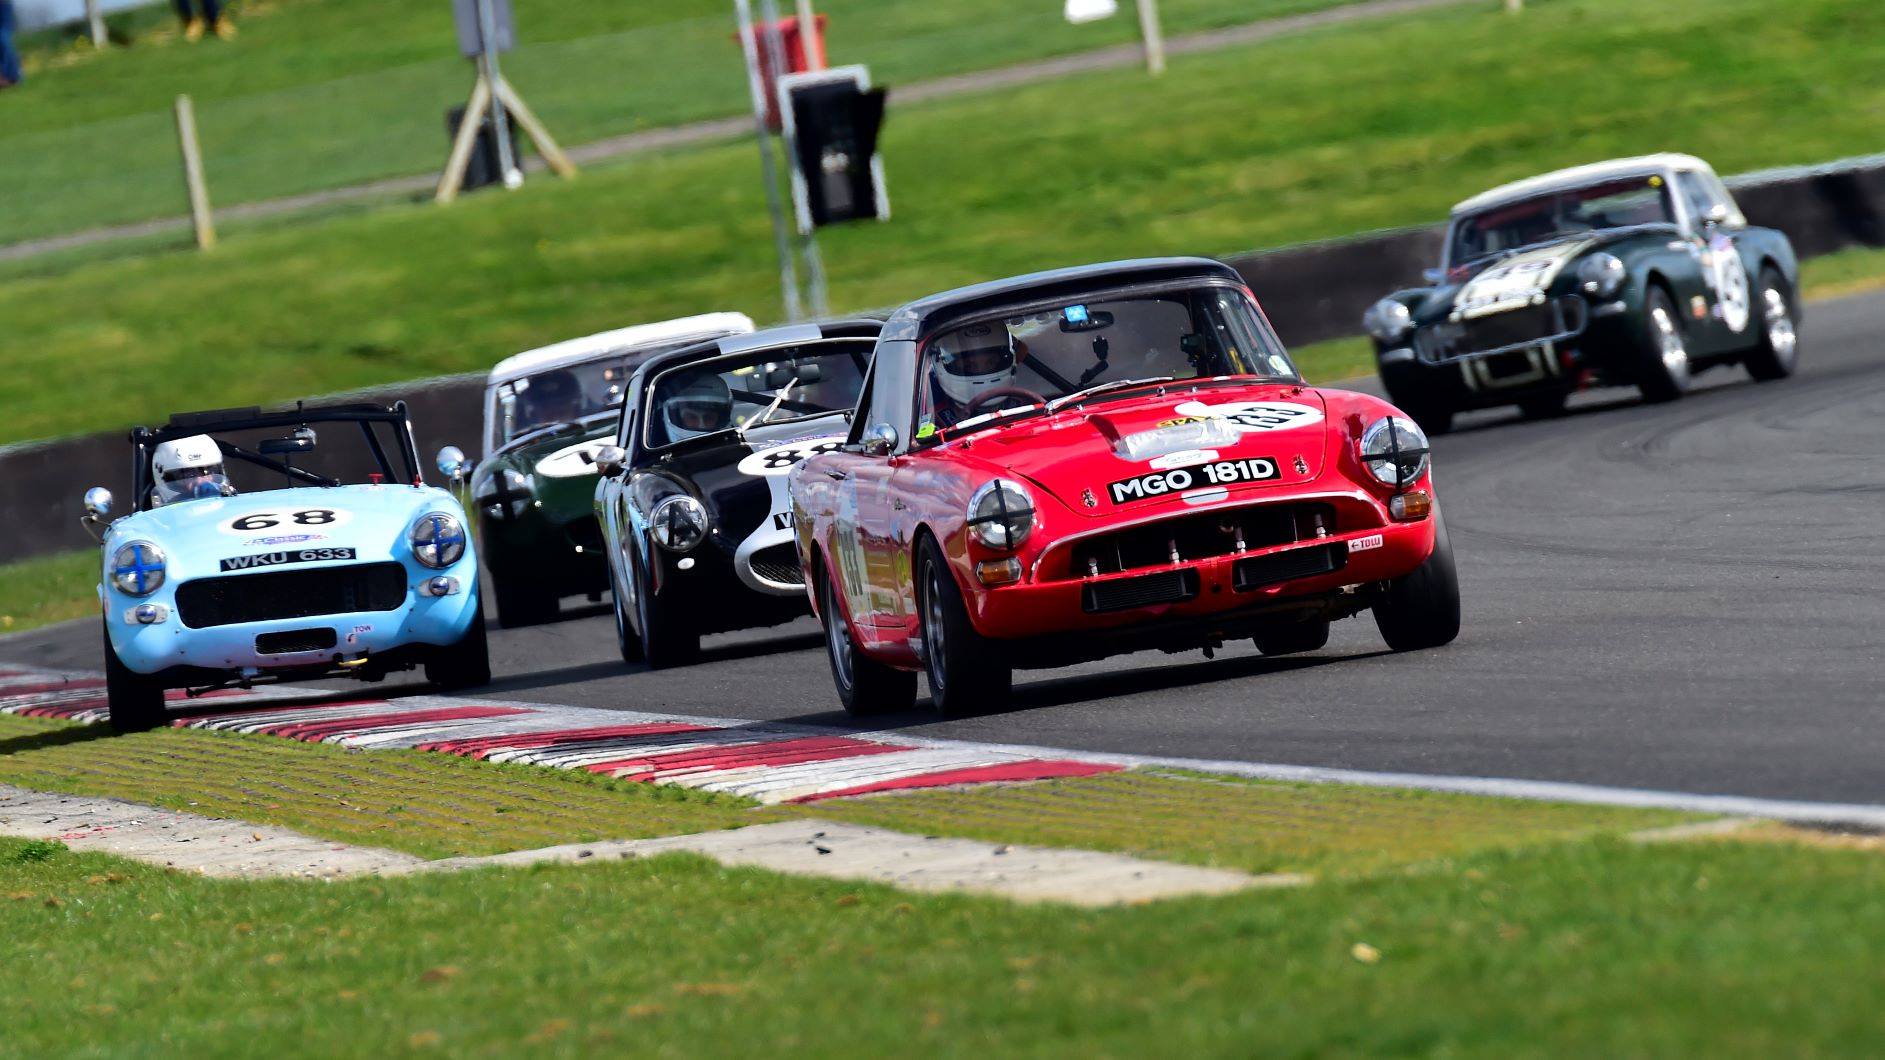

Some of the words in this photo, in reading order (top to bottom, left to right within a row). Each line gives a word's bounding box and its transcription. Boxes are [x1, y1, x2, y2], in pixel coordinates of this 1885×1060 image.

[1112, 470, 1192, 502] MGO
[1202, 459, 1274, 483] 181D
[232, 509, 336, 530] 68
[1360, 537, 1381, 548] TOW
[226, 551, 288, 569] WKU
[299, 548, 351, 561] 633
